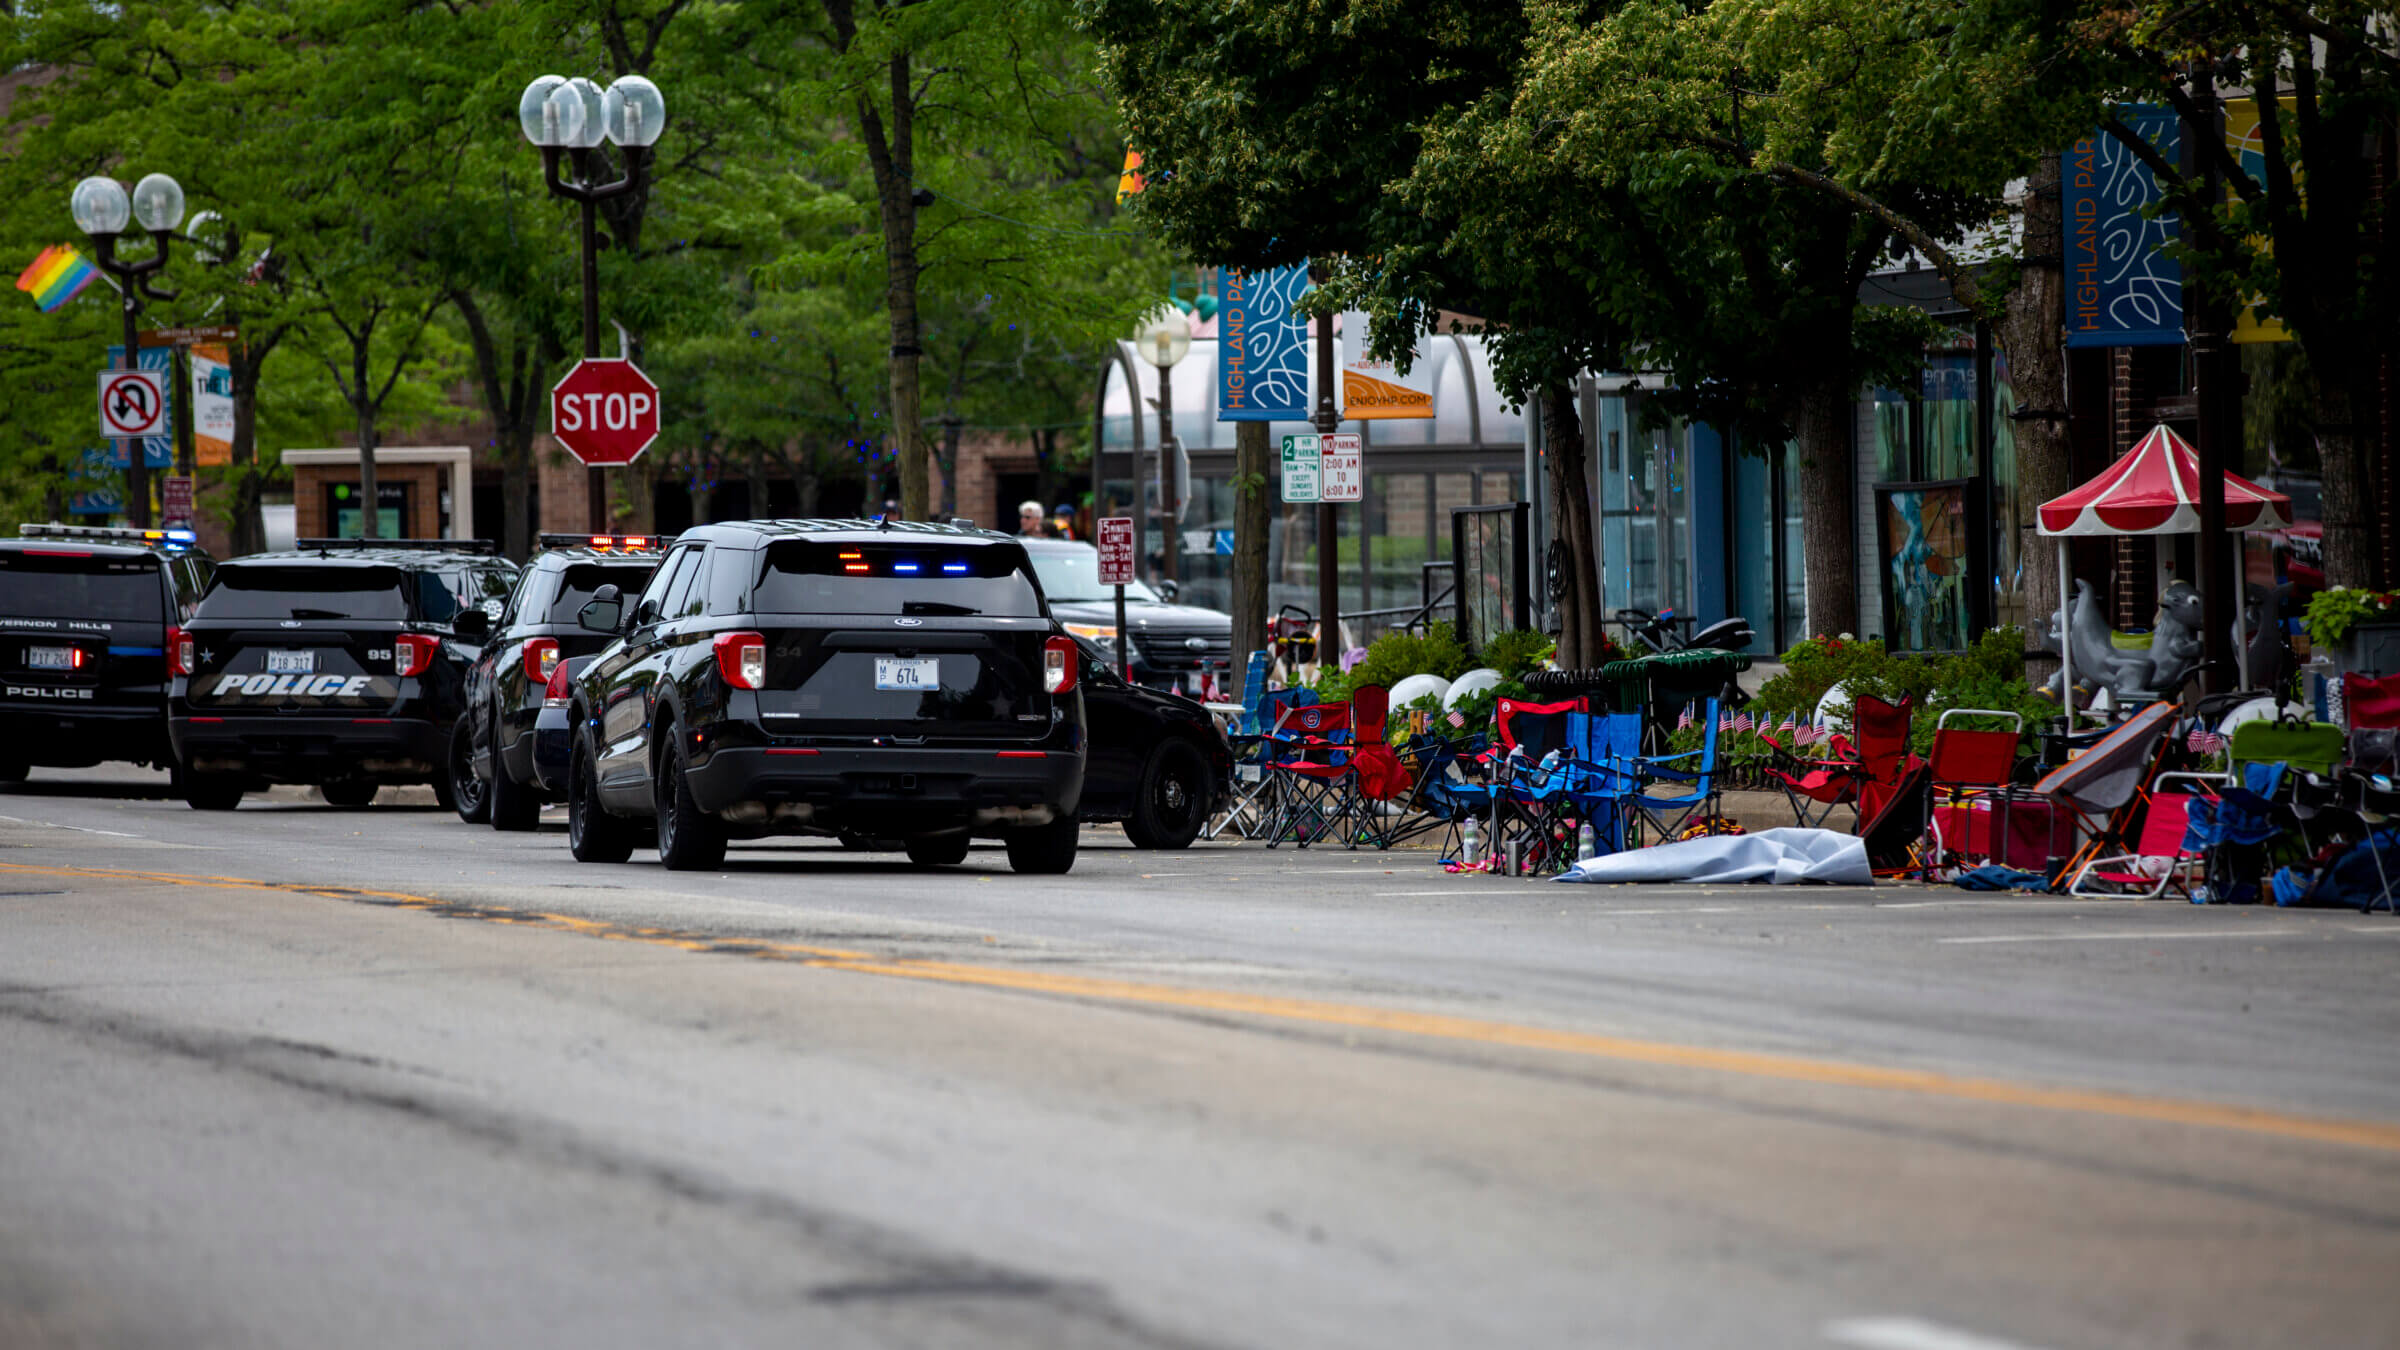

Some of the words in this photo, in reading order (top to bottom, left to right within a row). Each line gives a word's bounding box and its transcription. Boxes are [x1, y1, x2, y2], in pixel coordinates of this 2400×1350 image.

[2074, 138, 2095, 188] PAR
[2076, 198, 2099, 330] HIGHLAND
[1227, 308, 1245, 408] HIGHLAND
[1349, 394, 1426, 406] ENJOYHP.COM
[561, 392, 651, 432] STOP
[1284, 439, 1292, 457] 2
[1323, 438, 1334, 451] NO
[1334, 440, 1360, 449] PARKING
[1295, 449, 1318, 457] PARKING
[1325, 459, 1343, 469] 2:00
[1346, 459, 1357, 469] AM
[1336, 471, 1346, 482] TO
[1326, 485, 1343, 496] 6:00
[1346, 485, 1358, 495] AM
[1106, 534, 1125, 543] LIMIT
[69, 621, 112, 631] HILLS
[367, 649, 392, 661] 95
[277, 657, 289, 670] 18
[293, 657, 310, 670] 317
[896, 667, 919, 684] 674
[212, 674, 373, 696] POLICE
[6, 686, 94, 699] POLICE
